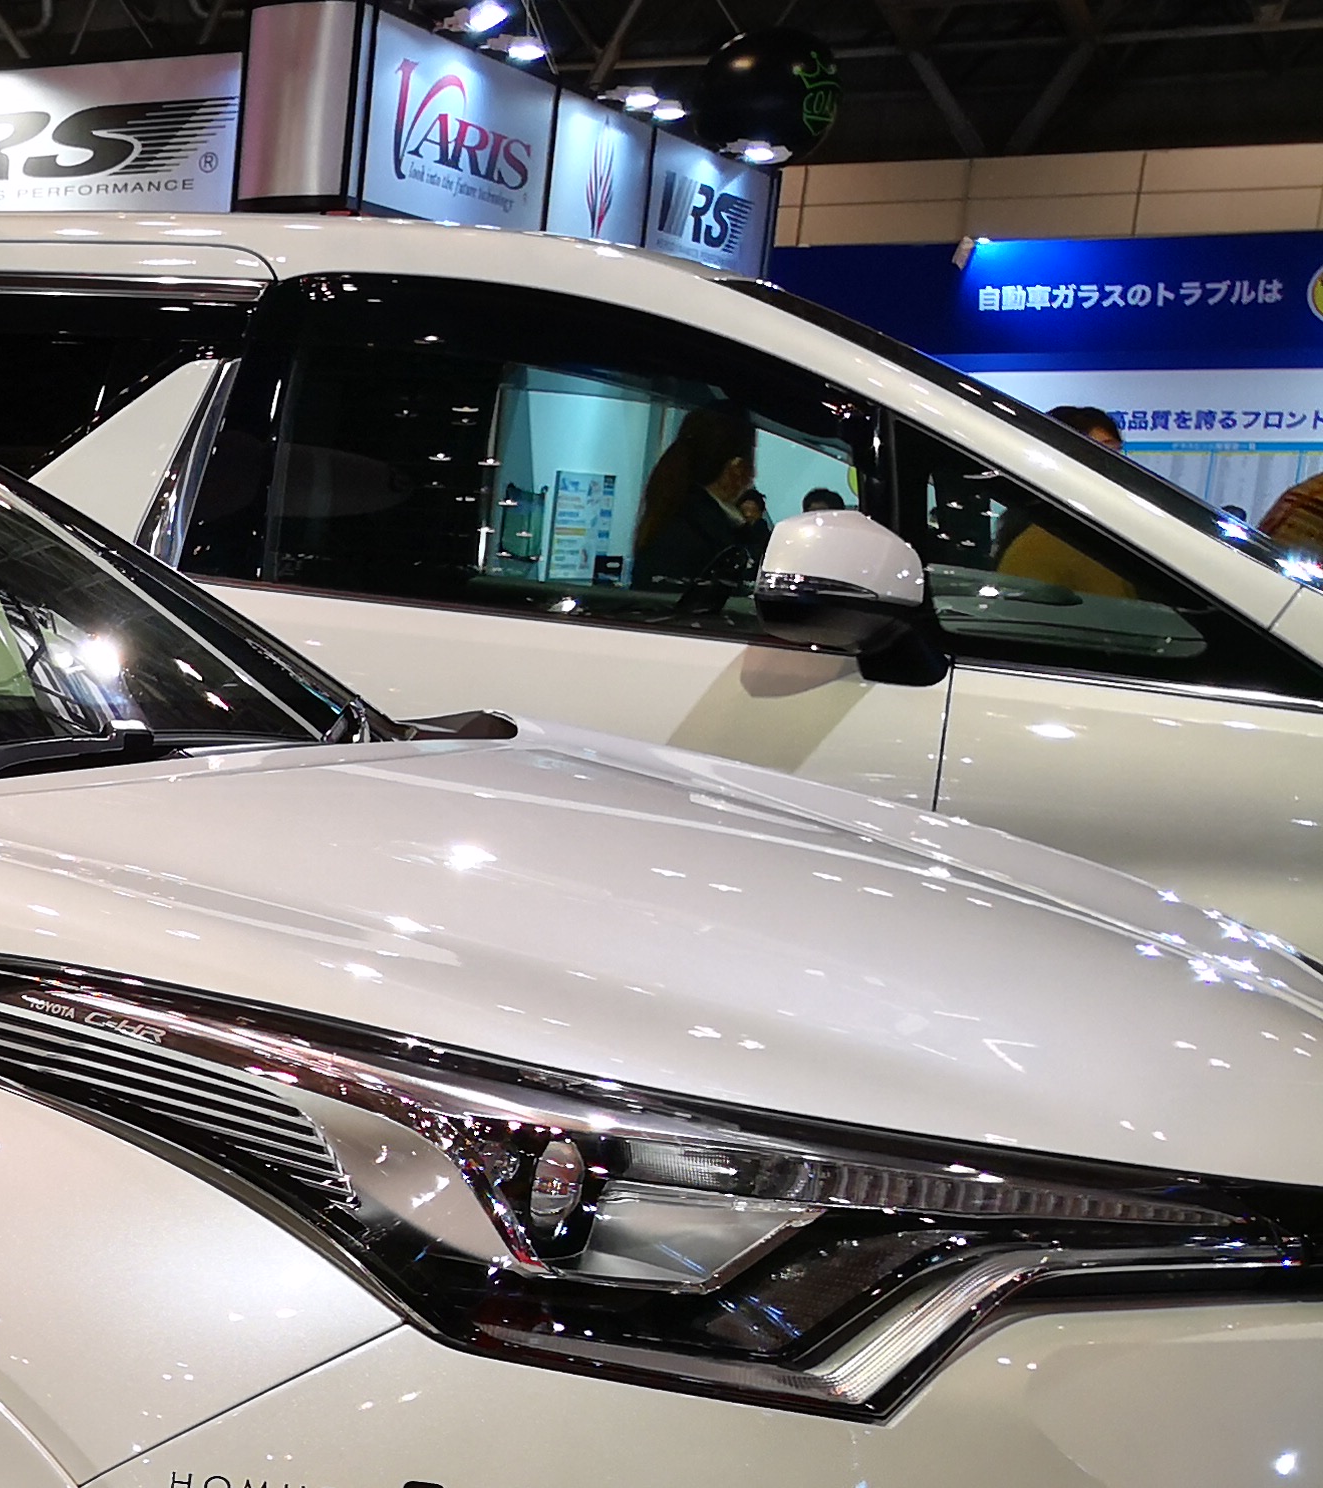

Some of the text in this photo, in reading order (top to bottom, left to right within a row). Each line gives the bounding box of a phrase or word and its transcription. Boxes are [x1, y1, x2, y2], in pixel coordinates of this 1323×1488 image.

[16, 178, 195, 200] PERFORMANCE
[978, 279, 1284, 311] 自動車ガラスのトラブルは
[28, 999, 75, 1019] TOYOTA
